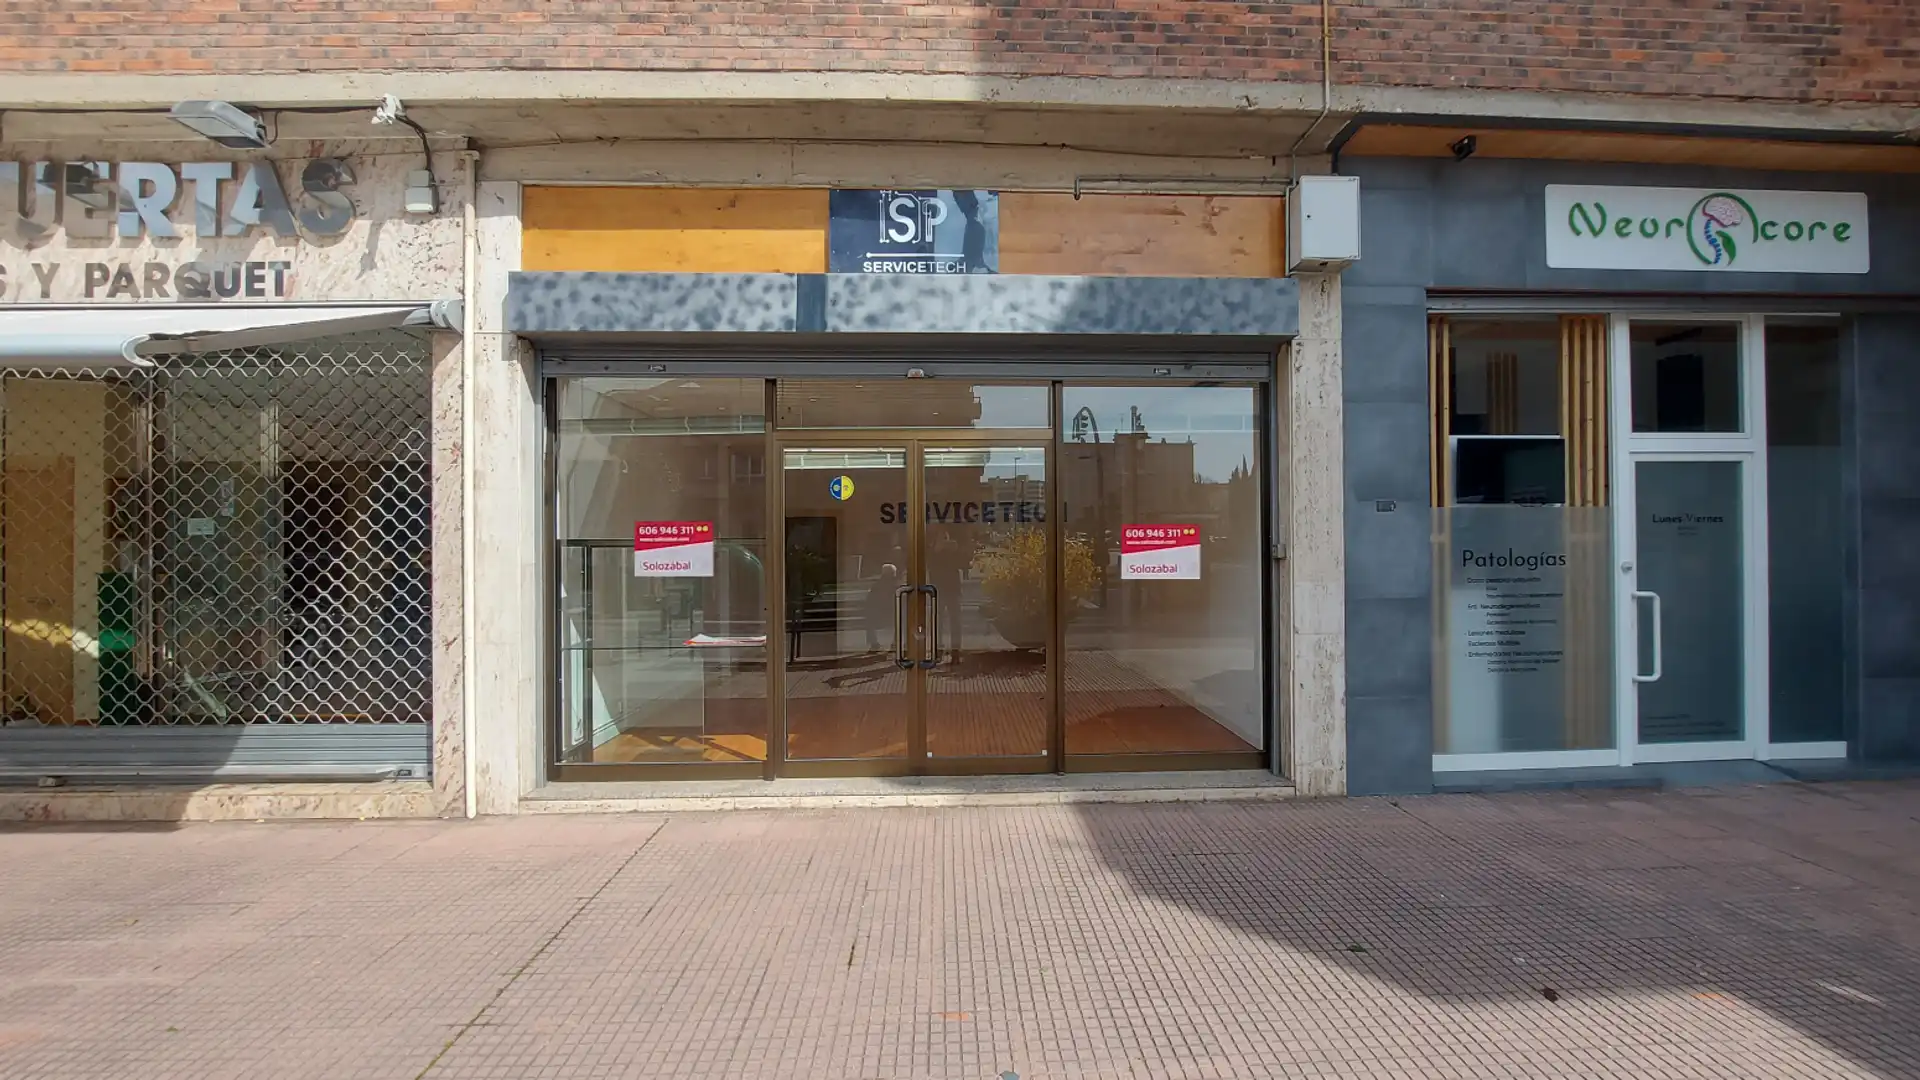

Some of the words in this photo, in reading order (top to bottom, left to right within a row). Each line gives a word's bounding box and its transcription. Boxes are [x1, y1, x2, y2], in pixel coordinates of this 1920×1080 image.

[862, 261, 967, 273] SERVICETECH
[31, 262, 60, 299] Y
[84, 262, 291, 299] PARQUET
[639, 526, 658, 535] 606
[660, 526, 678, 535] 946
[680, 526, 694, 535] 311
[1125, 528, 1145, 538] 606
[1146, 528, 1165, 538] 946
[1167, 528, 1181, 538] 311
[1462, 548, 1567, 571] Patologías
